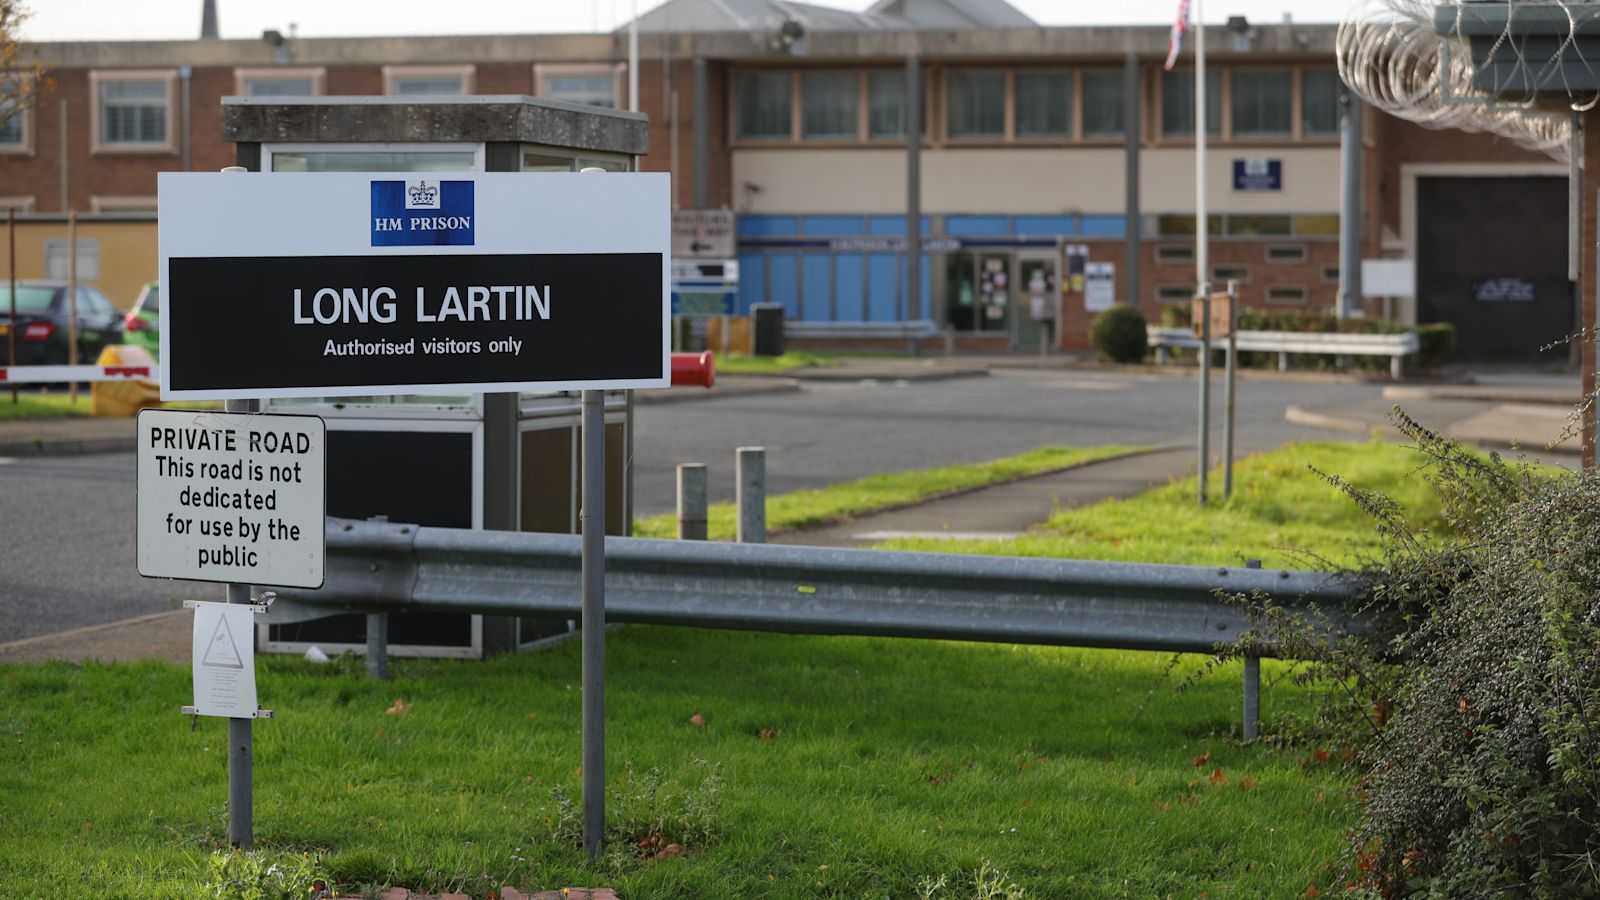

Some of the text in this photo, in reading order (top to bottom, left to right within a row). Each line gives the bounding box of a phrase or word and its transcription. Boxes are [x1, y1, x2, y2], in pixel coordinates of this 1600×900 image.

[375, 216, 471, 231] HM PRISON
[293, 285, 551, 325] LONG LARTIN
[323, 336, 523, 356] Authorised visitors only
[151, 427, 310, 455] PRIVATE ROAD
[155, 455, 302, 484] This road is not
[179, 485, 276, 511] dedicated
[166, 512, 300, 543] for use by the
[198, 544, 258, 569] public
